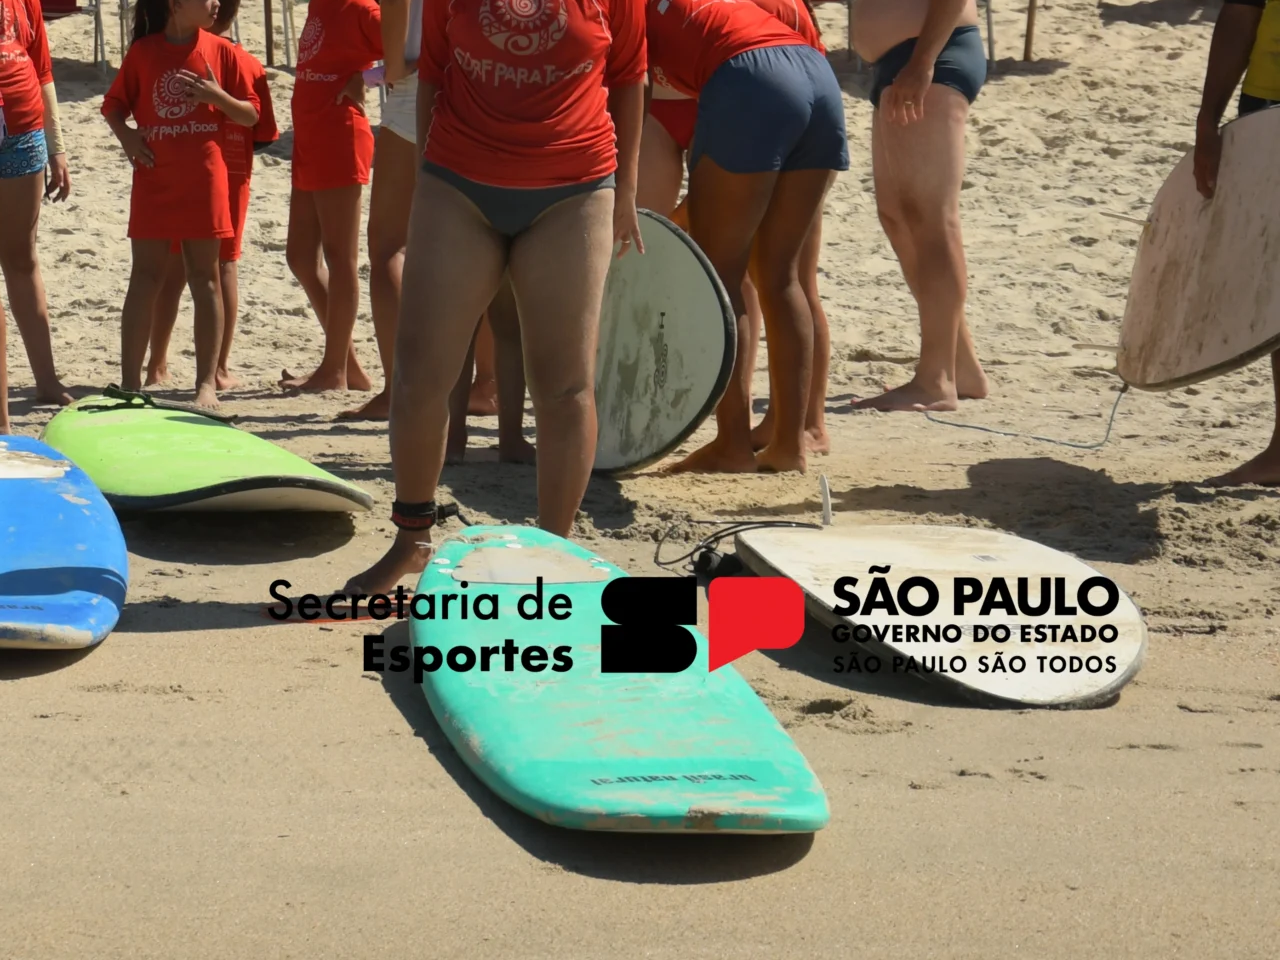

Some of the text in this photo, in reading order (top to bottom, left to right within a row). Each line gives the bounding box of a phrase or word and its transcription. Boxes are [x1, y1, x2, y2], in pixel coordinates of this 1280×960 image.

[495, 60, 542, 88] PARA
[159, 124, 189, 141] PARA
[188, 121, 219, 134] TODOS
